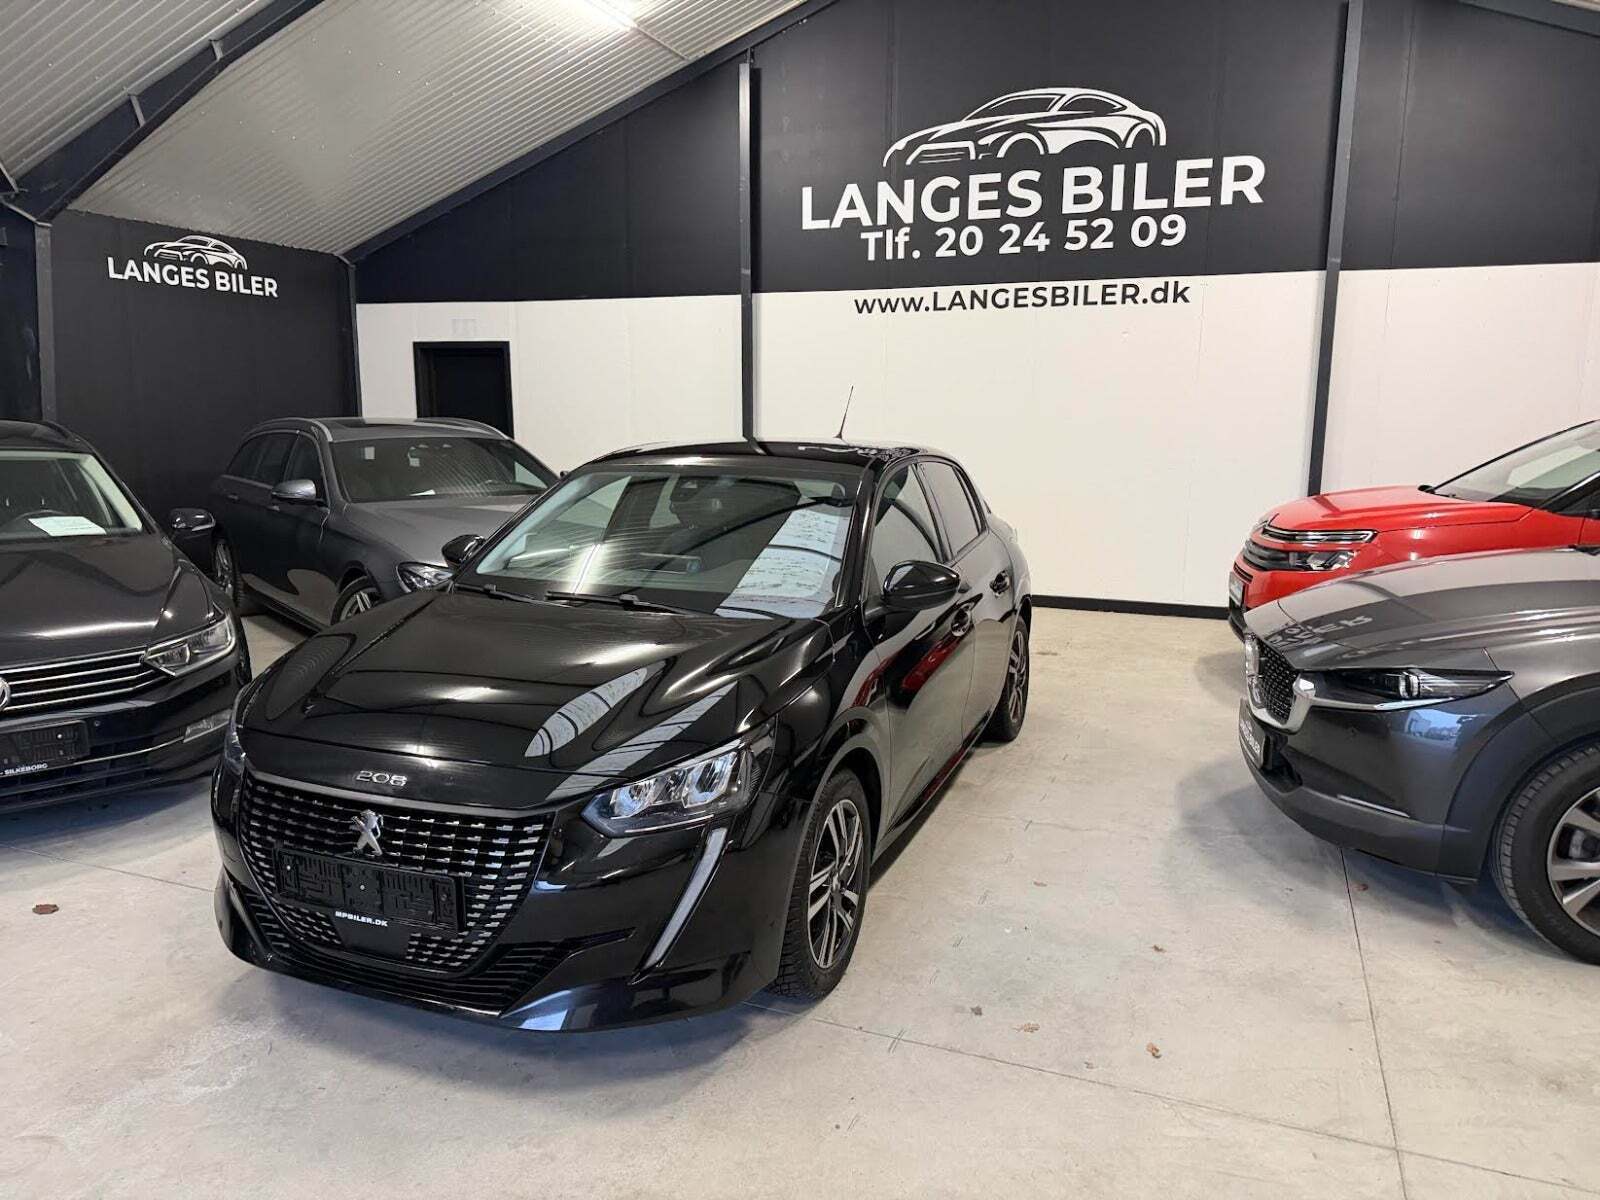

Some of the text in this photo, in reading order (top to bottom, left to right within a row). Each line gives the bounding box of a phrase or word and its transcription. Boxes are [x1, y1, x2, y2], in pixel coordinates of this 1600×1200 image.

[802, 155, 1266, 230] LANGES BILER
[861, 213, 1187, 261] Tlf. 20 24 52 09
[107, 257, 278, 298] LANGES BILER
[854, 280, 1191, 315] www.LANGESBILER.dk
[356, 770, 407, 787] 208
